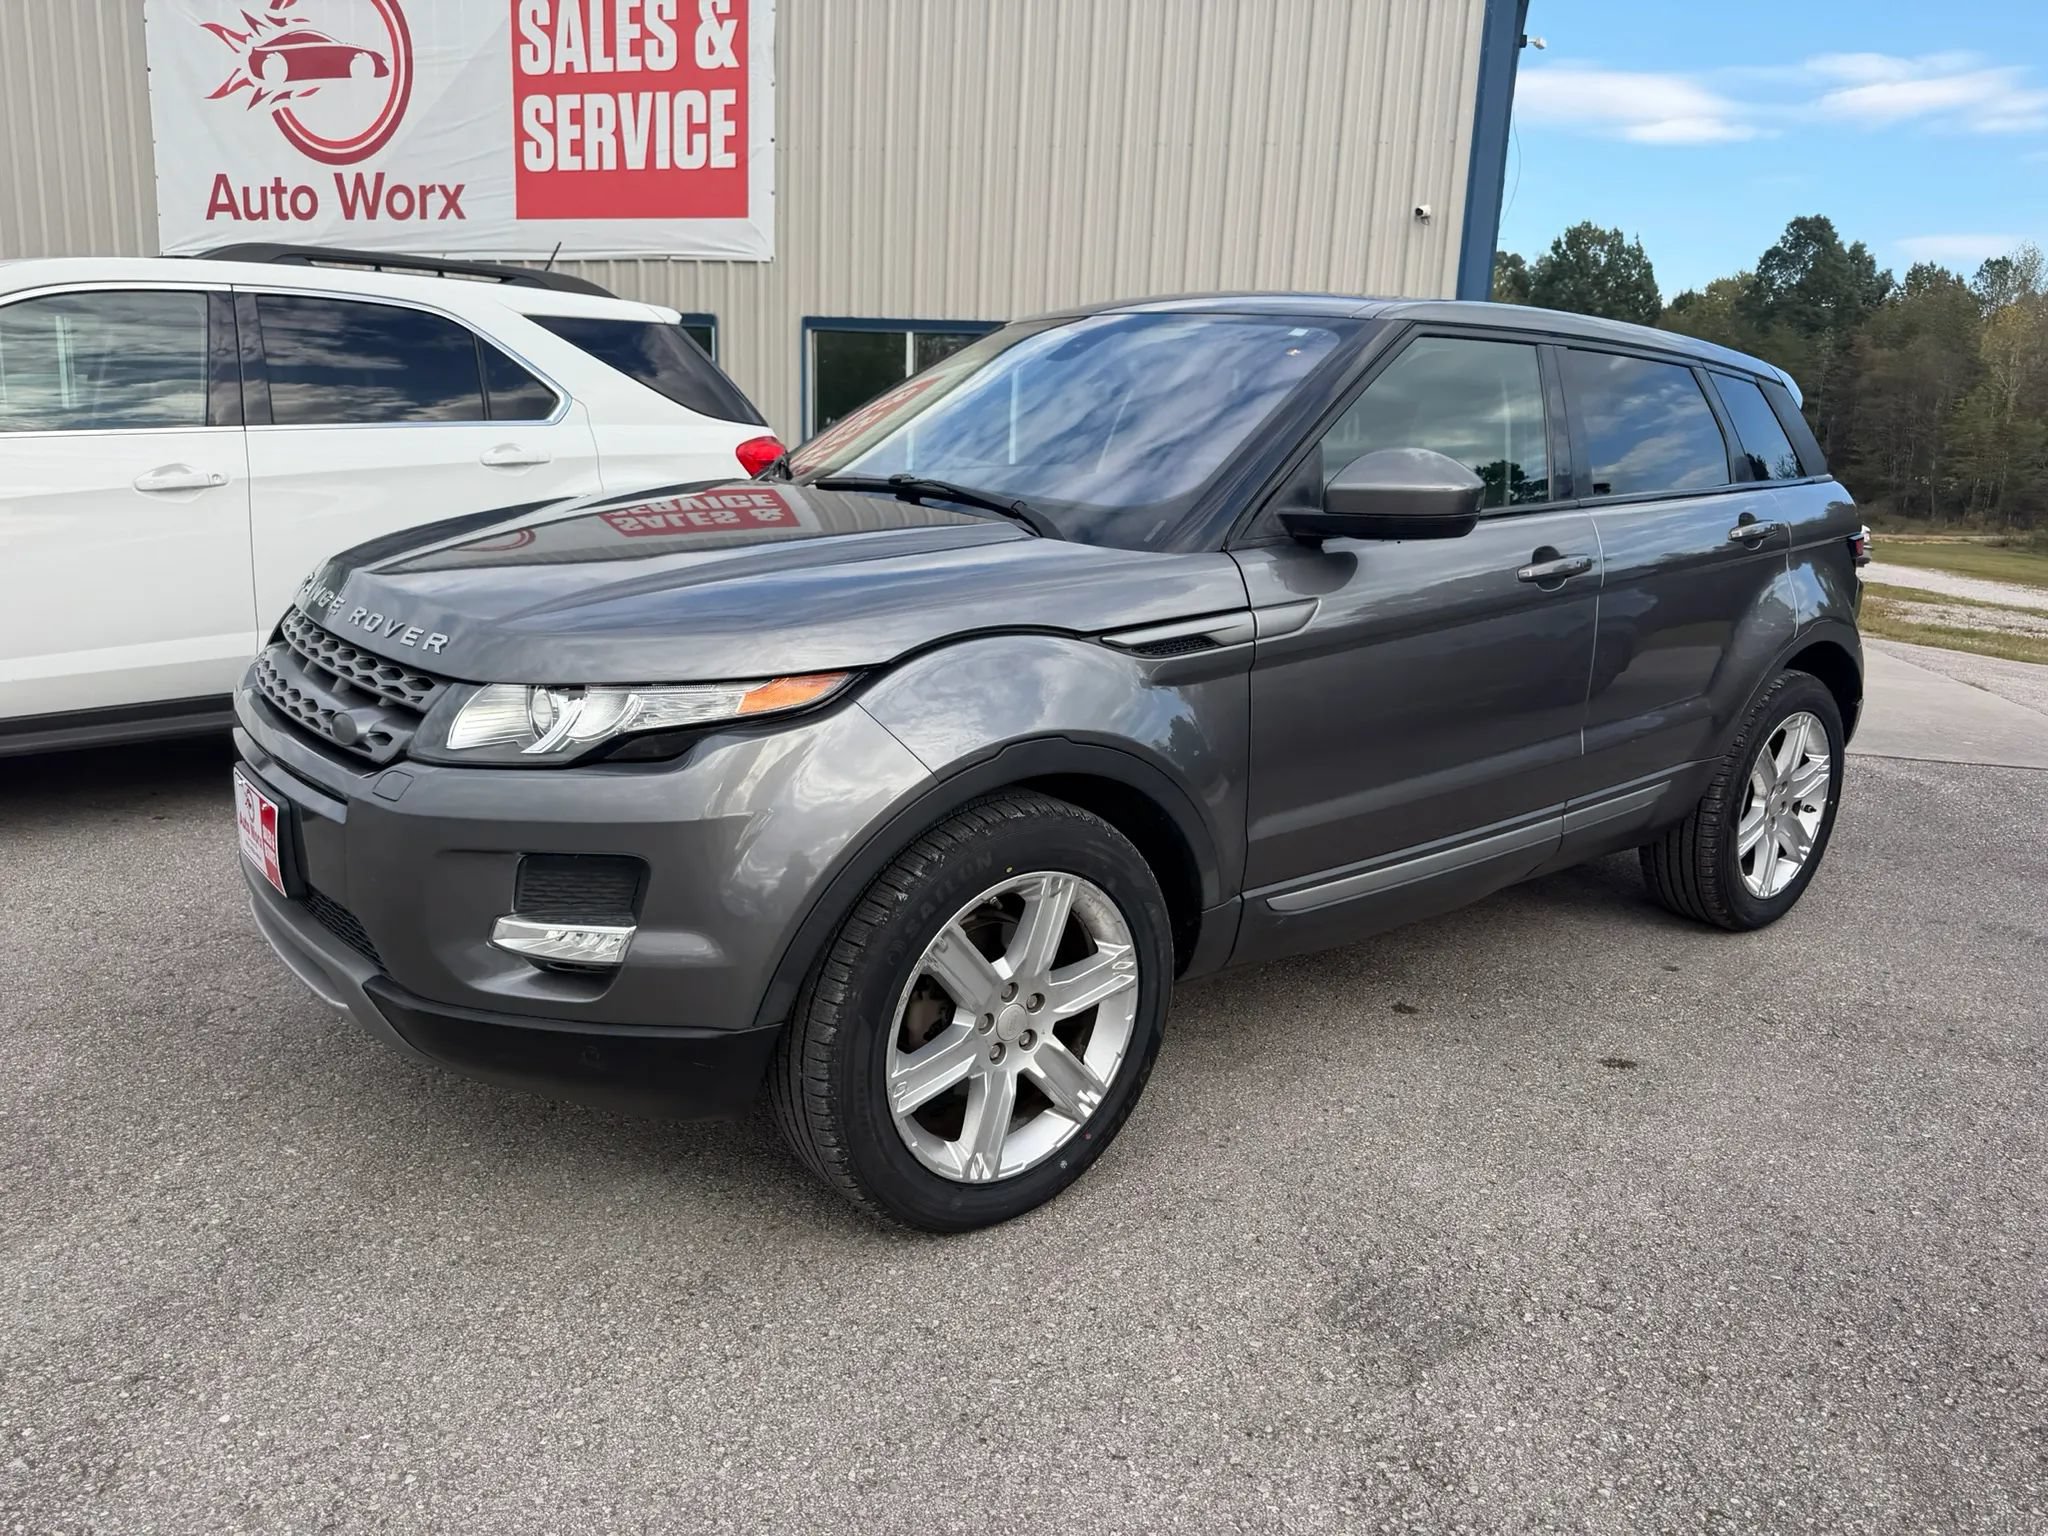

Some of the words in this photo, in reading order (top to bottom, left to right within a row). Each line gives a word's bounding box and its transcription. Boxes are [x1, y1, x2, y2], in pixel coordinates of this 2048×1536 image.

[518, 0, 678, 75] SALES
[695, 0, 740, 69] &
[522, 88, 737, 172] SERVICE
[205, 174, 319, 221] Auto
[334, 172, 466, 221] Worx
[348, 606, 449, 654] ROVER
